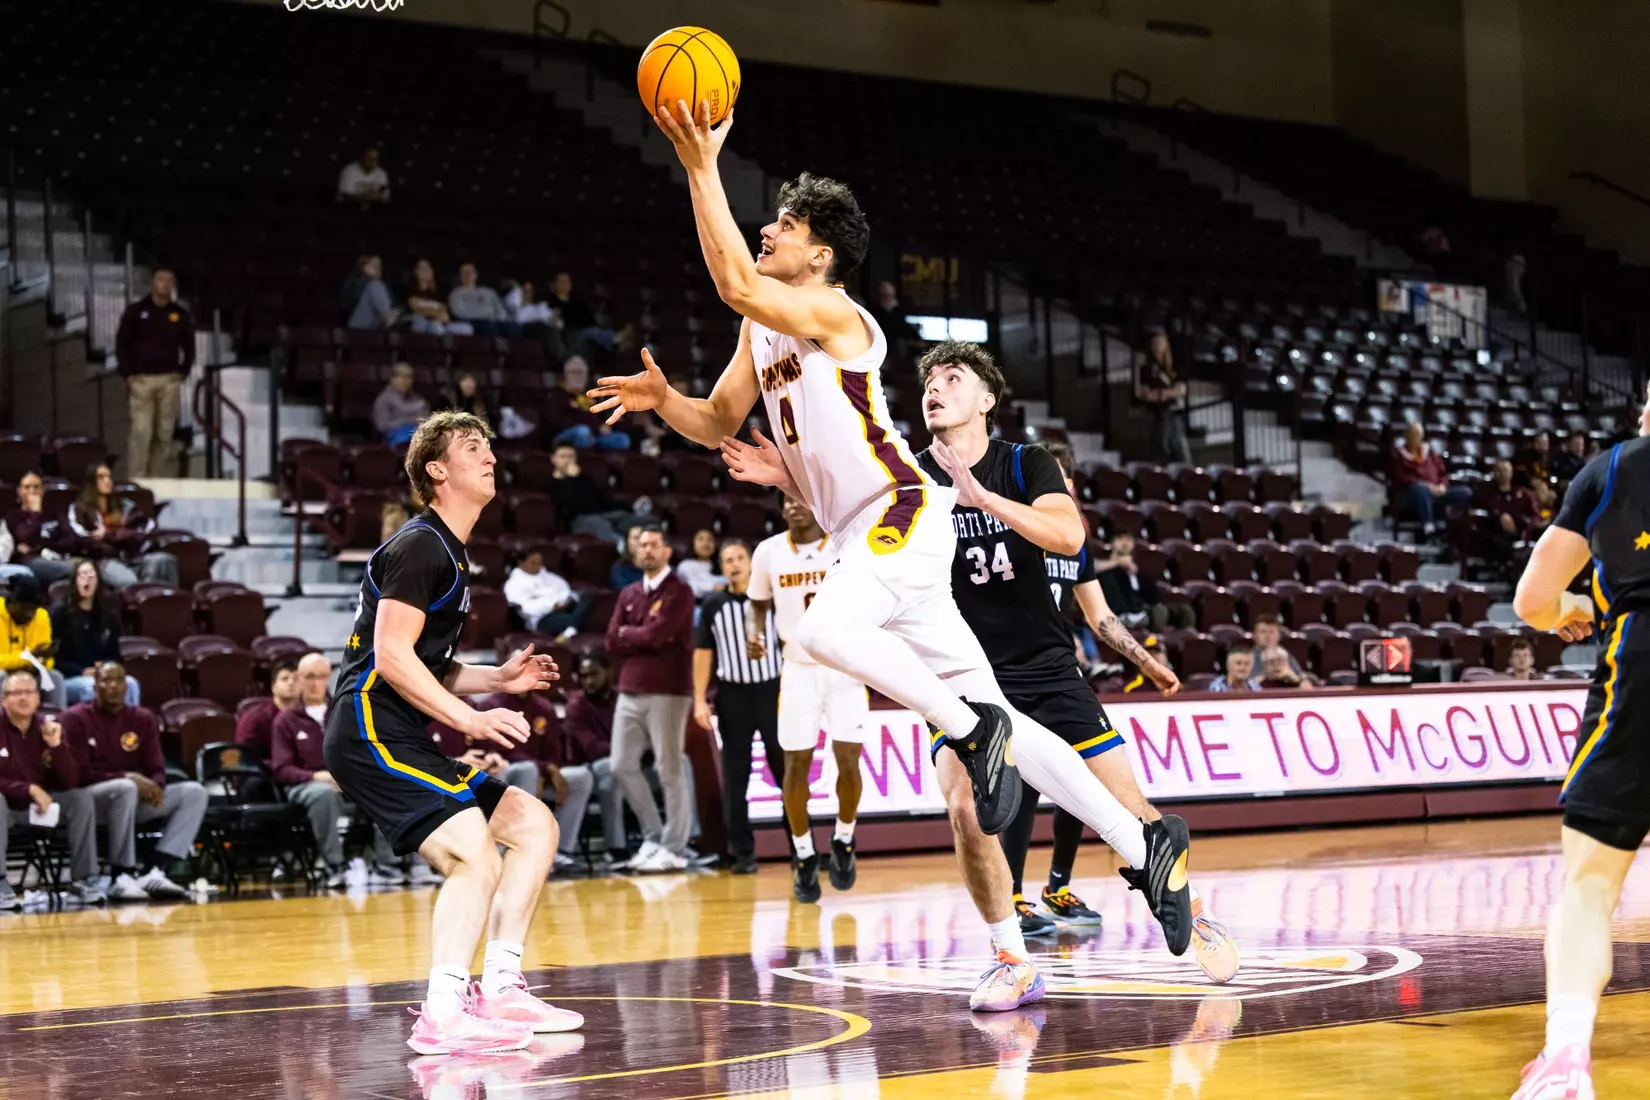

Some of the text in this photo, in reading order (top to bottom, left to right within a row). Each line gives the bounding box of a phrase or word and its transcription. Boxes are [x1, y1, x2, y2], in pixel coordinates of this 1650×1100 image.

[779, 570, 827, 588] CHIPPE
[965, 541, 1015, 585] 34
[1250, 710, 1340, 777] TO
[1356, 703, 1582, 773] McGUIR
